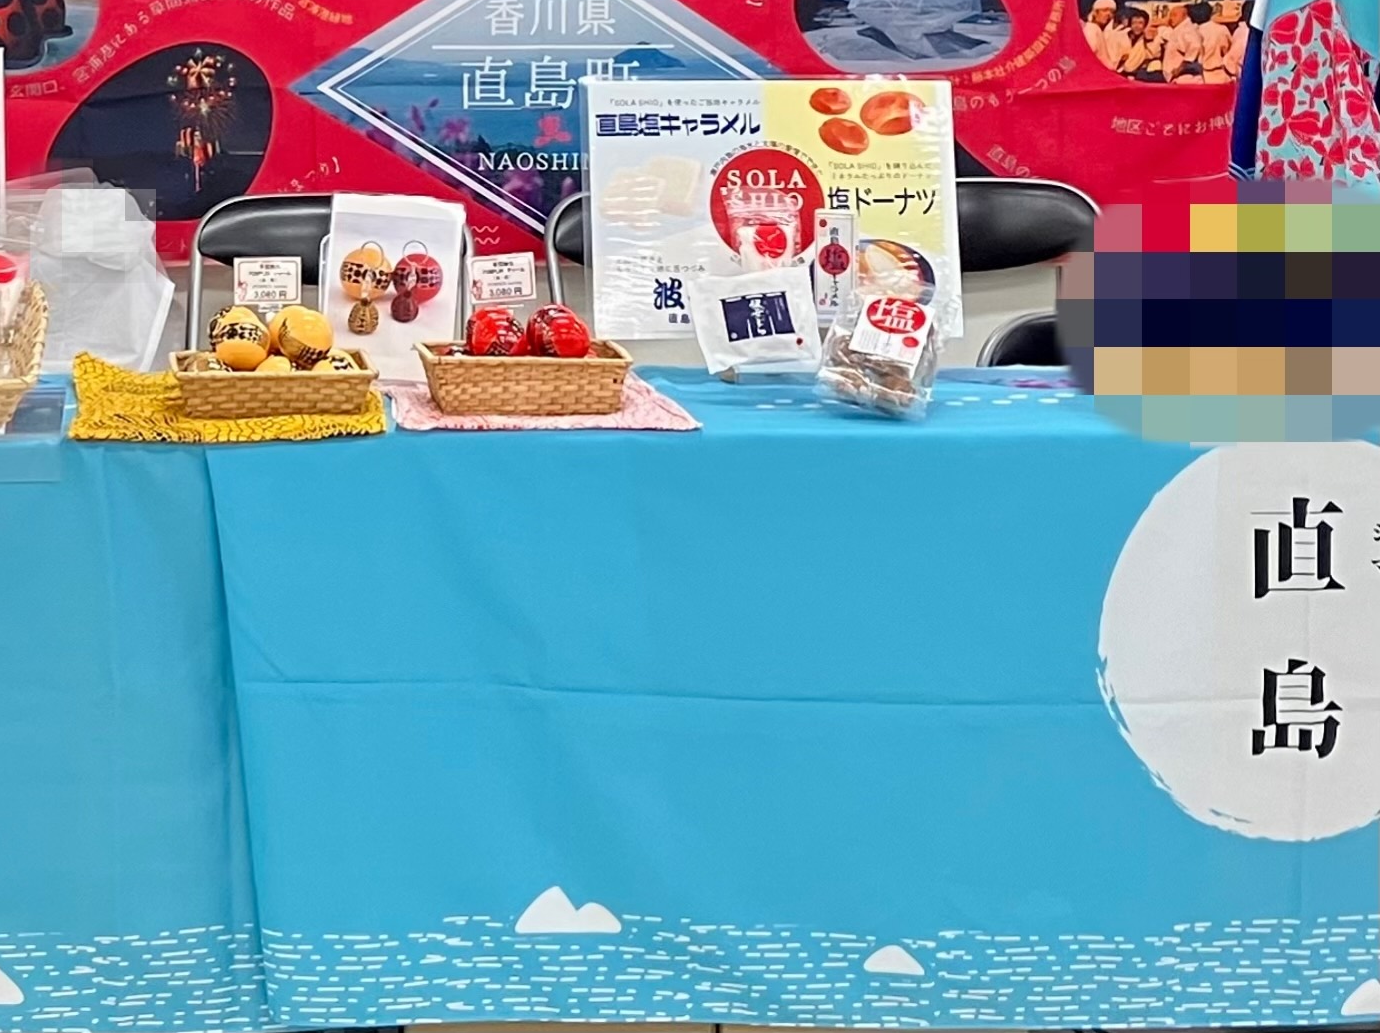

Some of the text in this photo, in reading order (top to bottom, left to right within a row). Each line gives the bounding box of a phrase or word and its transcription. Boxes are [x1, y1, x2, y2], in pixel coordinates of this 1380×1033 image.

[595, 113, 760, 136] 直島塩キャラメル
[478, 152, 589, 171] NAOSHI
[727, 169, 807, 189] SOLA
[730, 192, 804, 210] SHIO
[828, 186, 936, 216] 塩ドーナツ
[870, 298, 921, 333] 塩
[1250, 497, 1344, 759] 直島
